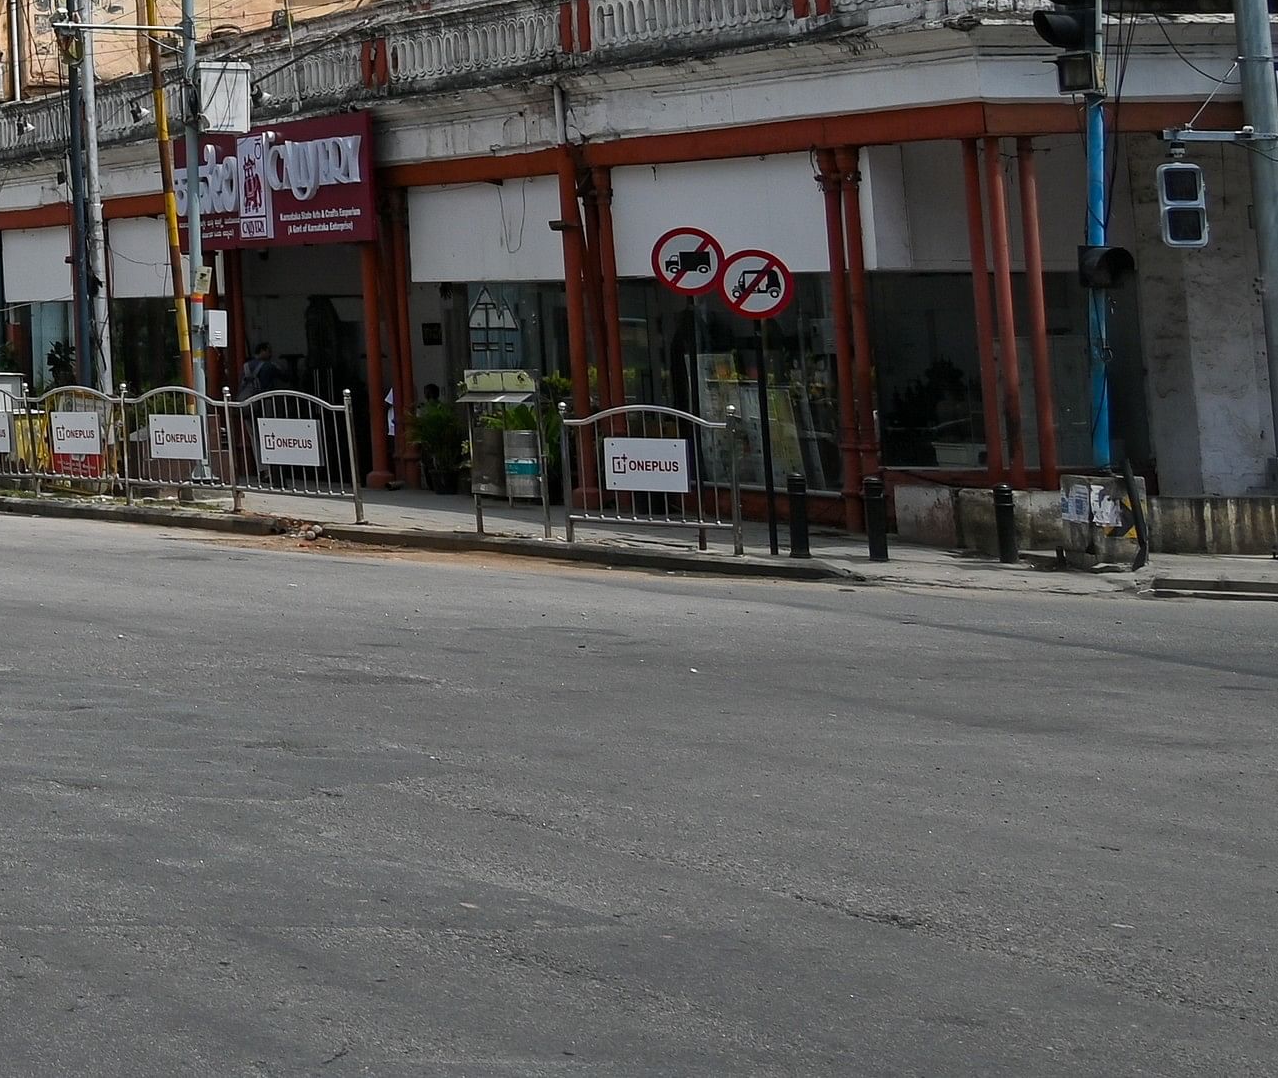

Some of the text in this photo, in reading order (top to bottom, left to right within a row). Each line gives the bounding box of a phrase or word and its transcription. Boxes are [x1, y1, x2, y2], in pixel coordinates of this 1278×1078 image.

[65, 429, 95, 439] ONEPLUS
[165, 433, 198, 443] ONEPLUS
[276, 438, 313, 449] ONEPLUS
[628, 460, 679, 472] ONEPLUS
